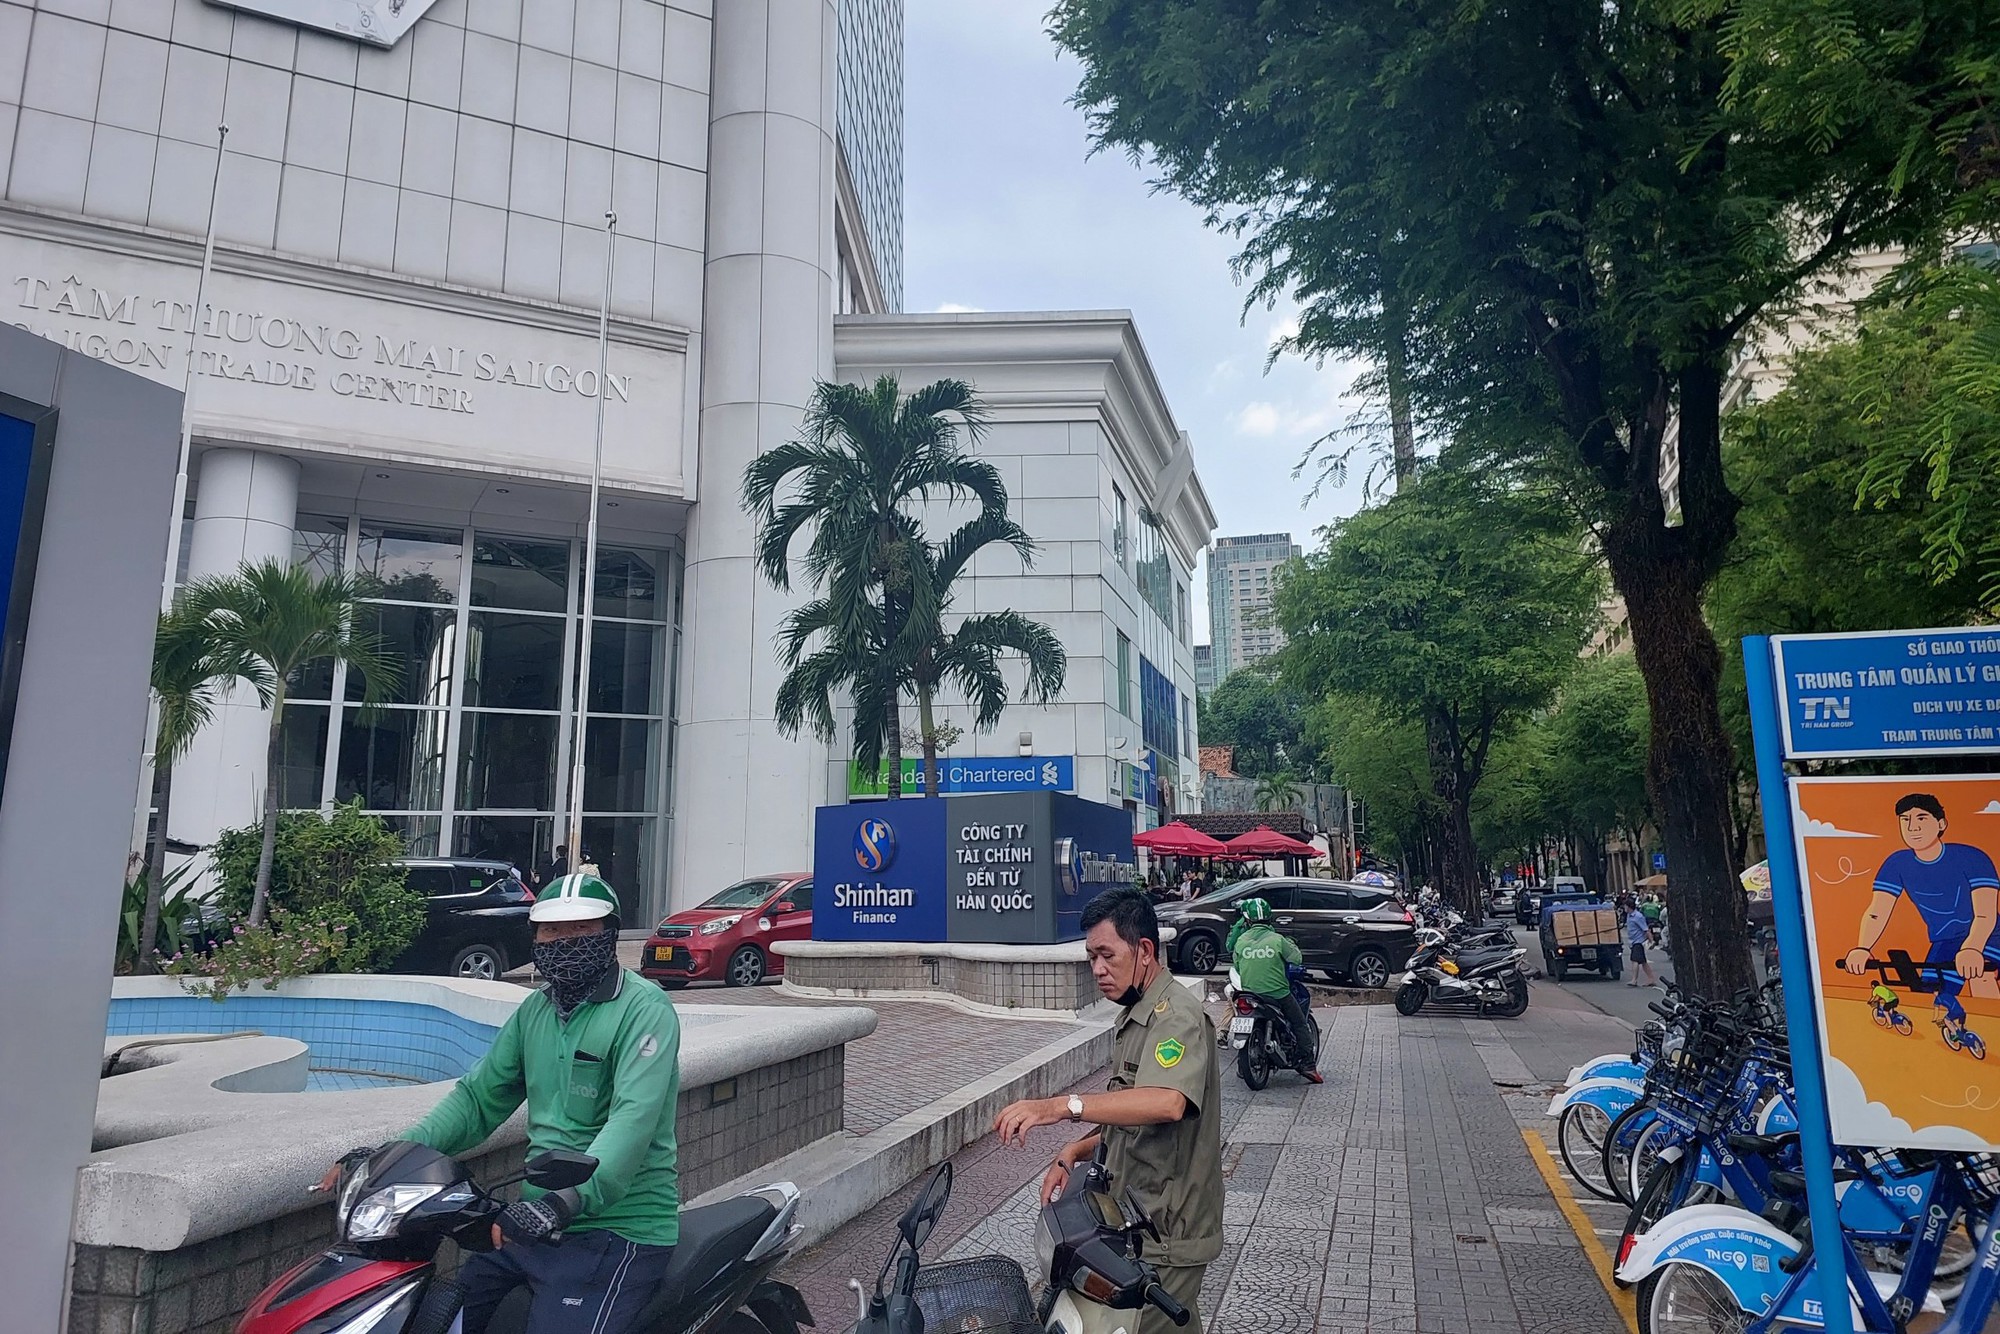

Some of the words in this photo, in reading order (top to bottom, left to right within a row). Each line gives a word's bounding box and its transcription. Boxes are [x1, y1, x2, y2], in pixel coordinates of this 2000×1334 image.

[14, 274, 140, 325] TÂM
[152, 298, 363, 359] THƯƠNG
[374, 335, 464, 379] MẠI
[474, 351, 631, 403] SAIGON
[330, 372, 474, 414] CENTER
[1907, 638, 1928, 656] SỞ
[1931, 640, 1965, 656] GIAO
[1968, 635, 2000, 653] THÔ
[1795, 671, 1853, 690] TRUNG
[1857, 666, 1896, 687] TÂM
[1901, 662, 1952, 685] QUẢN
[1955, 662, 1976, 683] LÝ
[1798, 696, 1850, 720] TN
[1913, 701, 1943, 716] DỊCH
[1945, 700, 1963, 715] VỤ
[1966, 699, 1983, 712] XE
[1882, 729, 1917, 745] TRẠM
[1920, 728, 1963, 741] TRUNG
[1965, 725, 1994, 740] TÂM
[949, 766, 1036, 784] Chartered
[961, 822, 1001, 842] CÔNG
[1005, 824, 1025, 840] TY
[956, 846, 980, 864] TÀI
[984, 843, 1032, 864] CHÍNH
[966, 867, 995, 887] ĐẾN
[1000, 867, 1021, 887] TỪ
[834, 883, 913, 907] Shinhan
[956, 890, 986, 910] HÀN
[990, 889, 1033, 913] QUỐC
[853, 911, 897, 923] Finance
[1242, 945, 1276, 960] Grab
[569, 1081, 599, 1099] Grab
[1713, 1136, 1735, 1166] TNGO
[1922, 1204, 1948, 1242] TNGO
